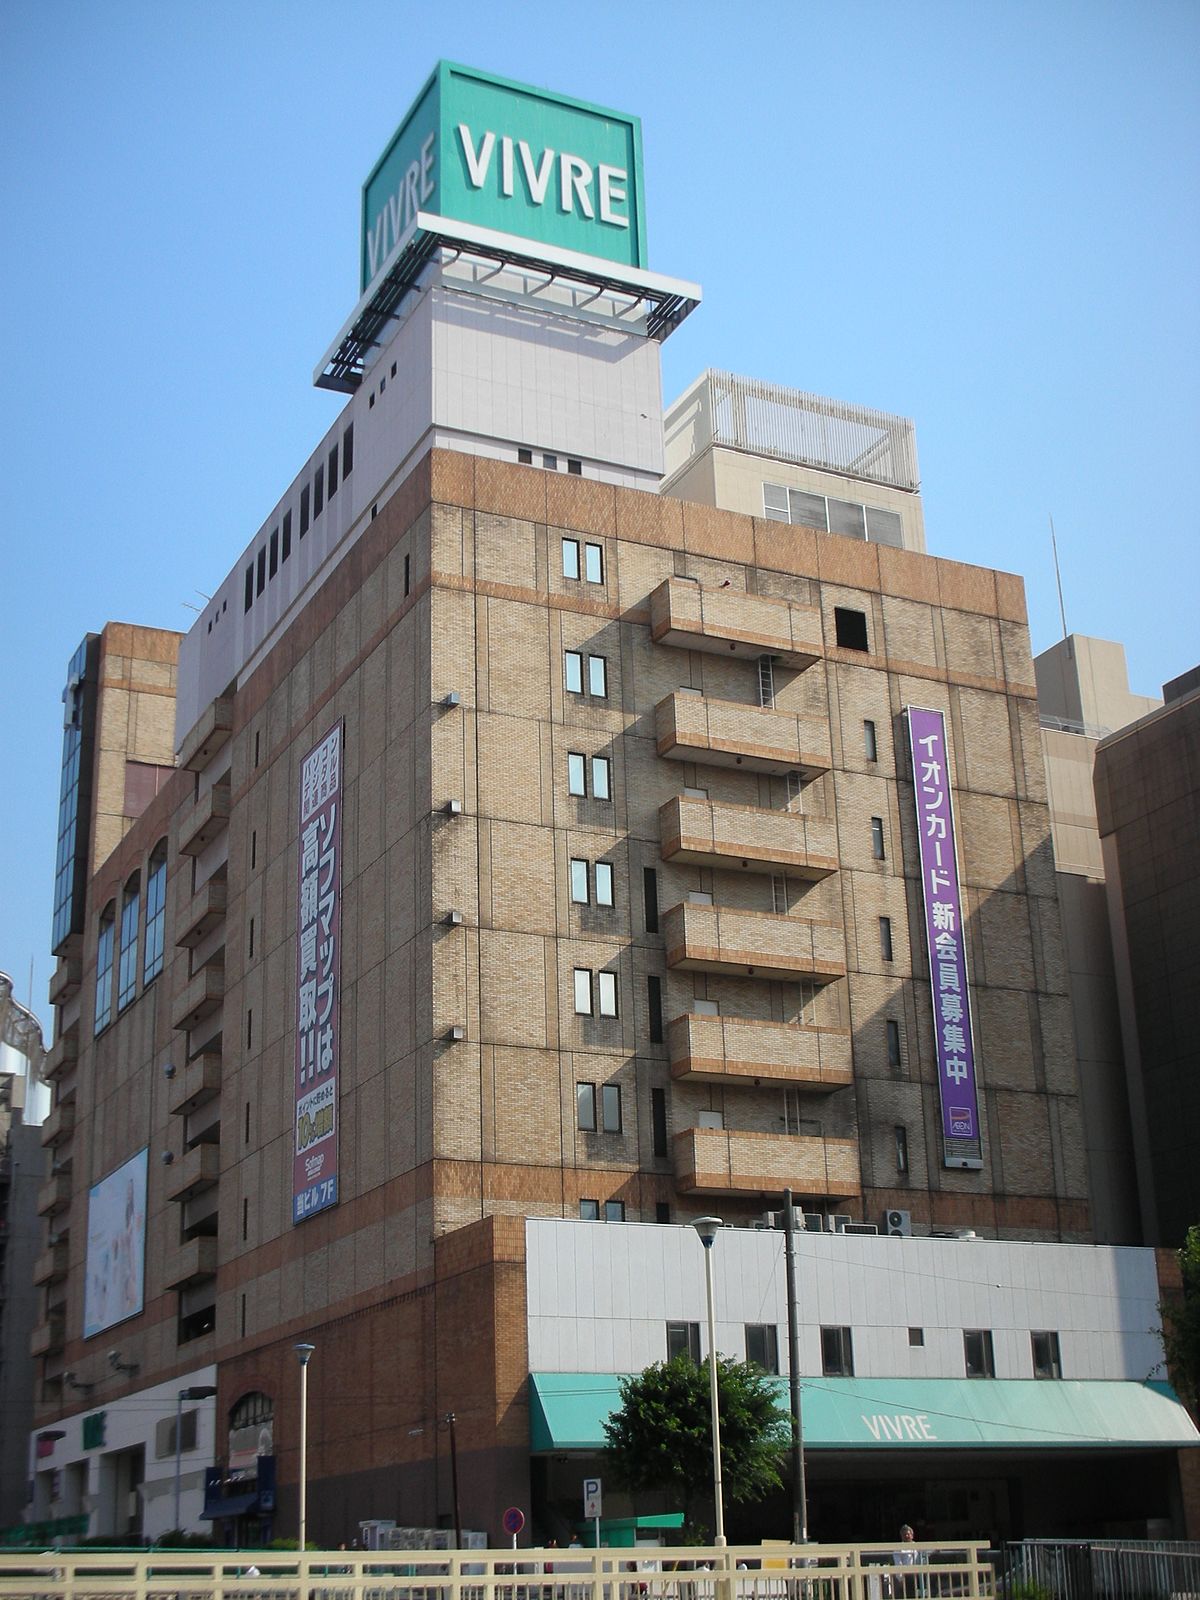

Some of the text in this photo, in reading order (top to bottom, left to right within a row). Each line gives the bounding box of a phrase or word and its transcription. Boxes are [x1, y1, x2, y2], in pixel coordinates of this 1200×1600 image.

[367, 130, 435, 279] VIVRE
[457, 122, 630, 229] VIVRE
[317, 802, 336, 1073] ソフマップは
[321, 1178, 334, 1203] 7F
[861, 1414, 938, 1440] VIVRE
[586, 1480, 598, 1501] P
